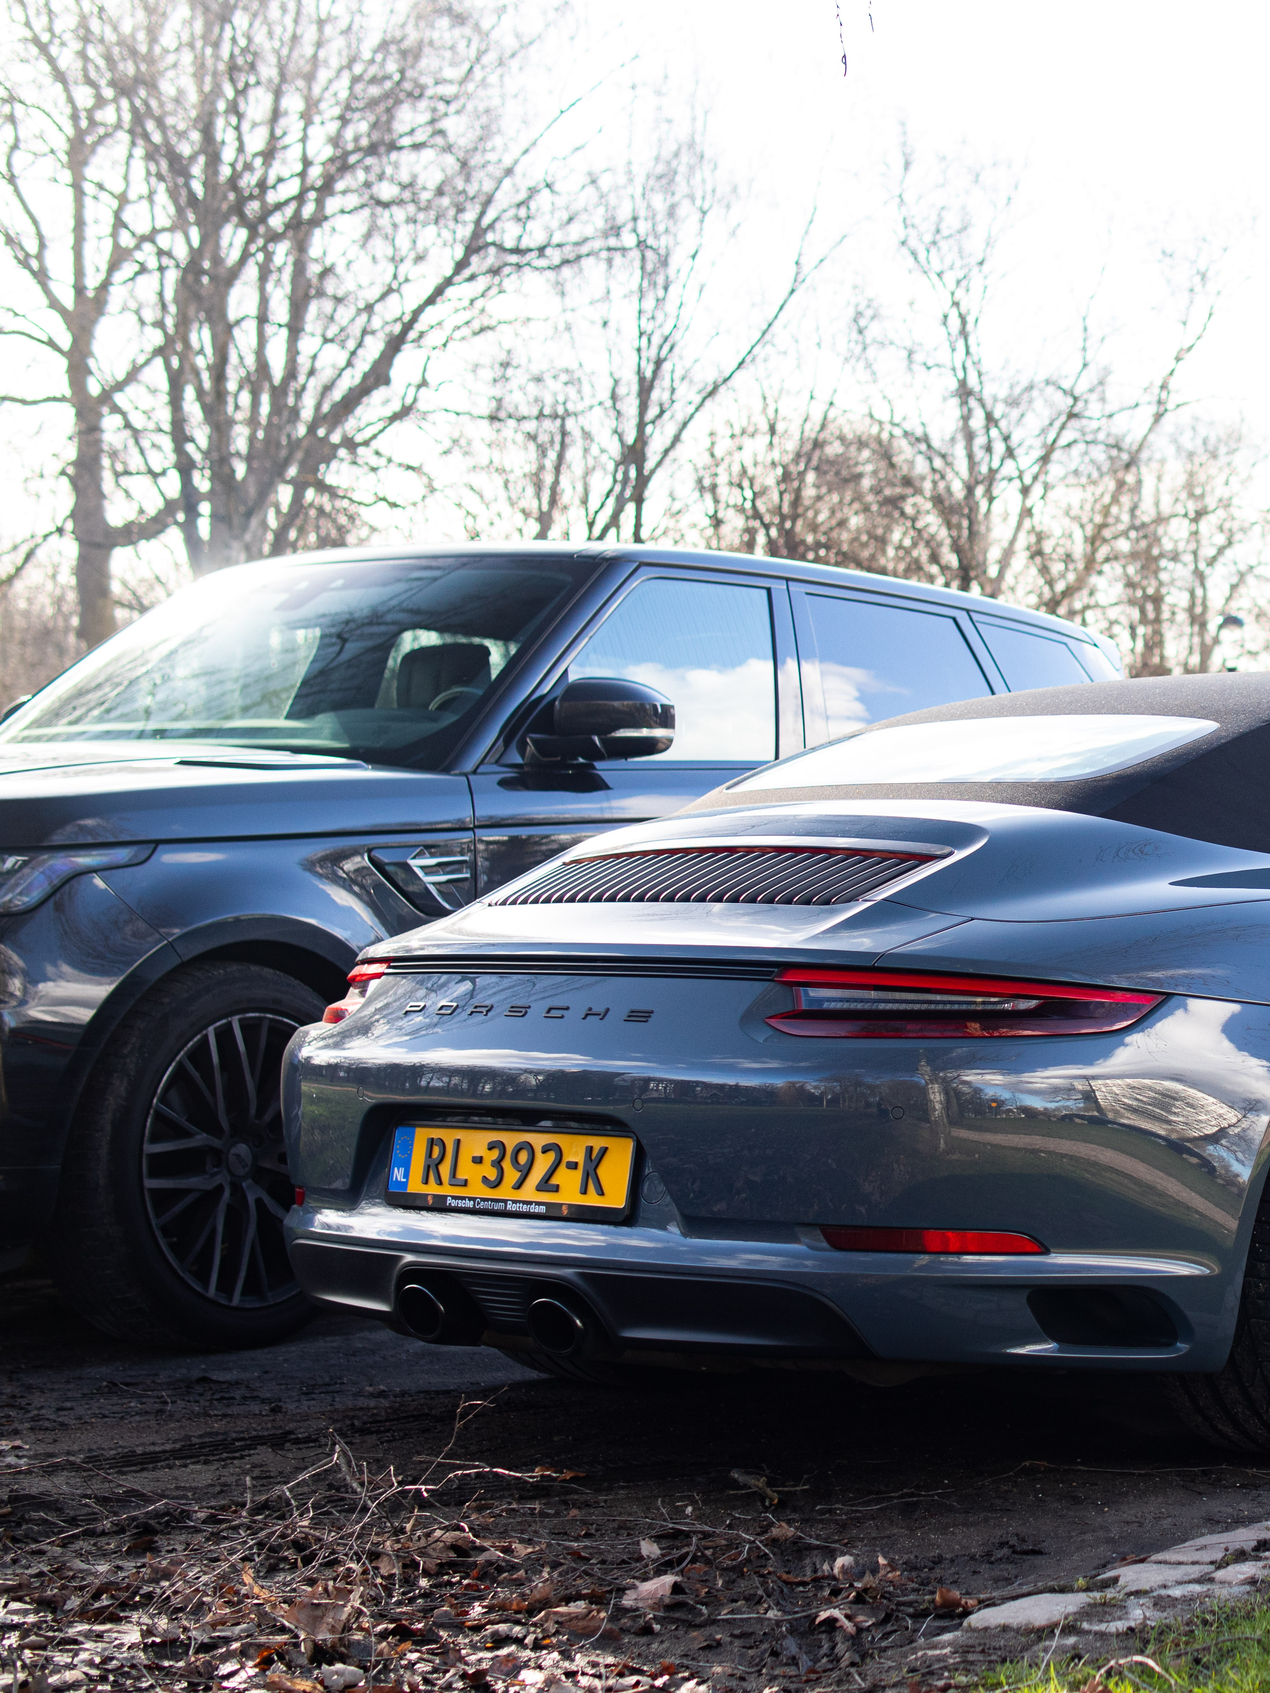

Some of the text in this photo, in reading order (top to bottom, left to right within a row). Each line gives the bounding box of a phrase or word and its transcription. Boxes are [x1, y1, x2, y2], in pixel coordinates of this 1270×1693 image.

[402, 1002, 654, 1023] PORSCHE
[393, 1167, 407, 1182] NL
[421, 1137, 609, 1196] RL-392-K
[446, 1196, 547, 1213] Porsche Centrum Rotterdam
